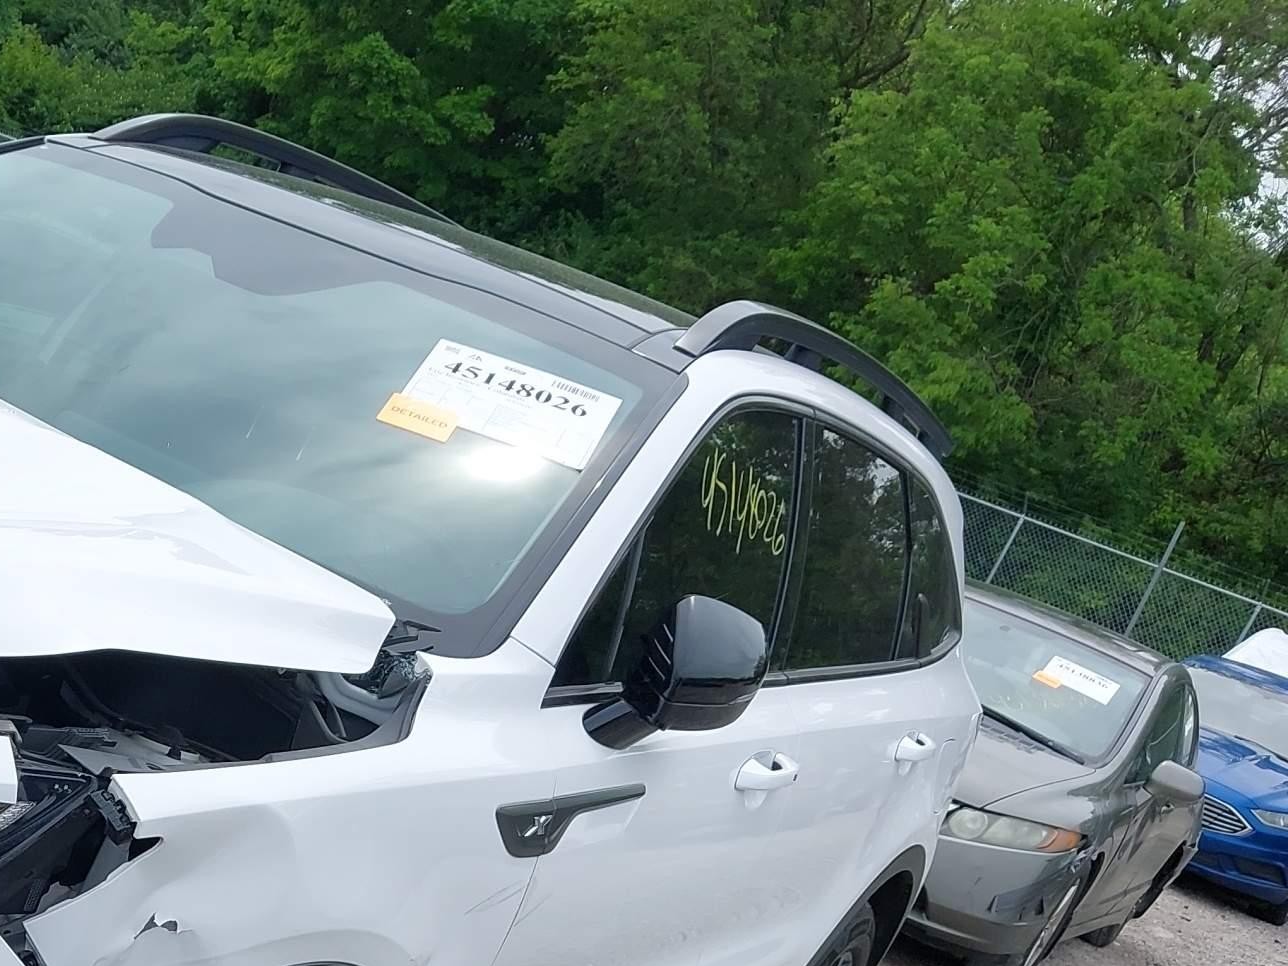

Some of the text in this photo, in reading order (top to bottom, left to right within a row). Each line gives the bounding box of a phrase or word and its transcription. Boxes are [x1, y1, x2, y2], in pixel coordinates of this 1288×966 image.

[391, 405, 449, 429] DETAILED
[444, 361, 587, 417] 45148026
[701, 447, 786, 555] 45148026
